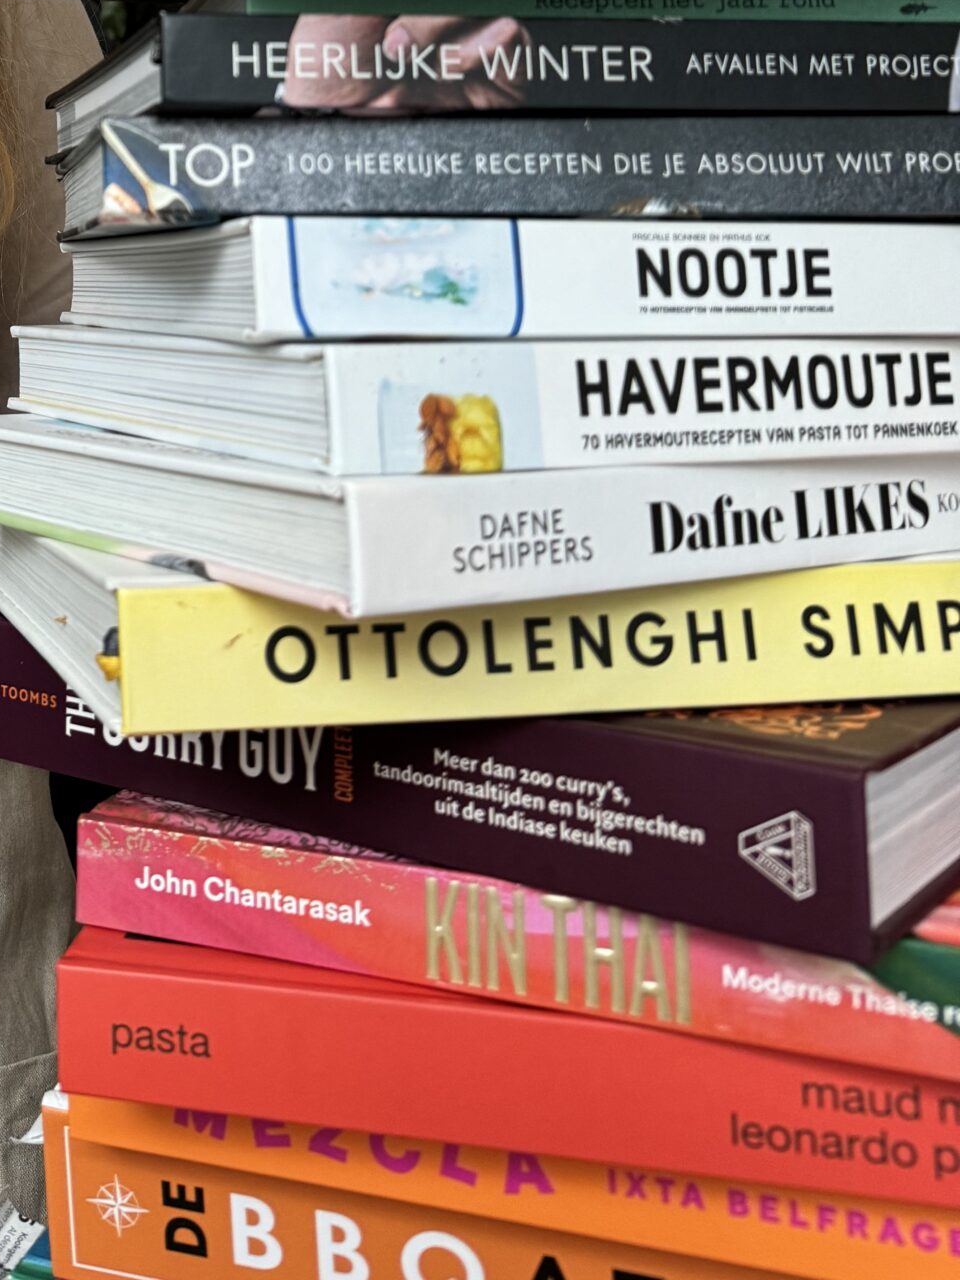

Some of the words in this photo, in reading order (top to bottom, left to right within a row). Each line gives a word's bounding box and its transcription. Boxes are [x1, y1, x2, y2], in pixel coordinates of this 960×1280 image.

[231, 41, 466, 81] HEERLIJKE
[479, 43, 654, 82] WINTER
[686, 52, 798, 76] AFVALLEN
[809, 53, 855, 76] MET
[866, 53, 960, 80] PROJECT
[158, 142, 256, 188] TOP
[286, 151, 333, 175] 100
[345, 151, 463, 178] HEERLIJKE
[475, 151, 602, 176] RECEPTEN
[614, 152, 653, 176] DIE
[662, 152, 686, 178] JE
[697, 151, 826, 177] ABSOLUUT
[836, 151, 894, 175] WILT
[636, 247, 833, 298] NOOTJE
[575, 351, 955, 418] HAVERMOUTJE
[581, 434, 601, 451] 70
[605, 428, 762, 450] HAVERMOUTRECEPTEN
[766, 427, 795, 443] VAN
[799, 425, 842, 443] PASTA
[845, 424, 869, 440] TOT
[874, 421, 959, 440] PANNENKOEK
[479, 508, 566, 541] DAFNE
[647, 493, 786, 555] Dafne
[790, 478, 931, 542] LIKES
[452, 535, 595, 574] SCHIPPERS
[265, 606, 759, 684] OTTOLENGHI
[1, 685, 59, 710] TOOMBS
[65, 683, 96, 738] TH
[240, 727, 326, 792] GUY
[433, 747, 479, 772] Meer
[481, 757, 516, 781] dan
[519, 768, 554, 789] 200
[373, 760, 546, 810] tandoorimaaltijden
[548, 798, 573, 818] en
[576, 799, 706, 846] bijgerechten
[434, 797, 461, 819] uit
[462, 800, 486, 824] de
[488, 807, 557, 840] Indiase
[559, 821, 633, 856] keuken
[134, 865, 198, 899] John
[203, 876, 373, 928] Chantarasak
[423, 876, 528, 997] KIN
[541, 893, 692, 1025] THAI
[721, 964, 841, 1008] Moderne
[846, 983, 940, 1024] Thaise
[110, 1022, 212, 1059] pasta
[801, 1081, 922, 1122] maud
[730, 1111, 919, 1170] leonardo
[606, 1167, 706, 1211] IXTA
[160, 1179, 209, 1259] DE
